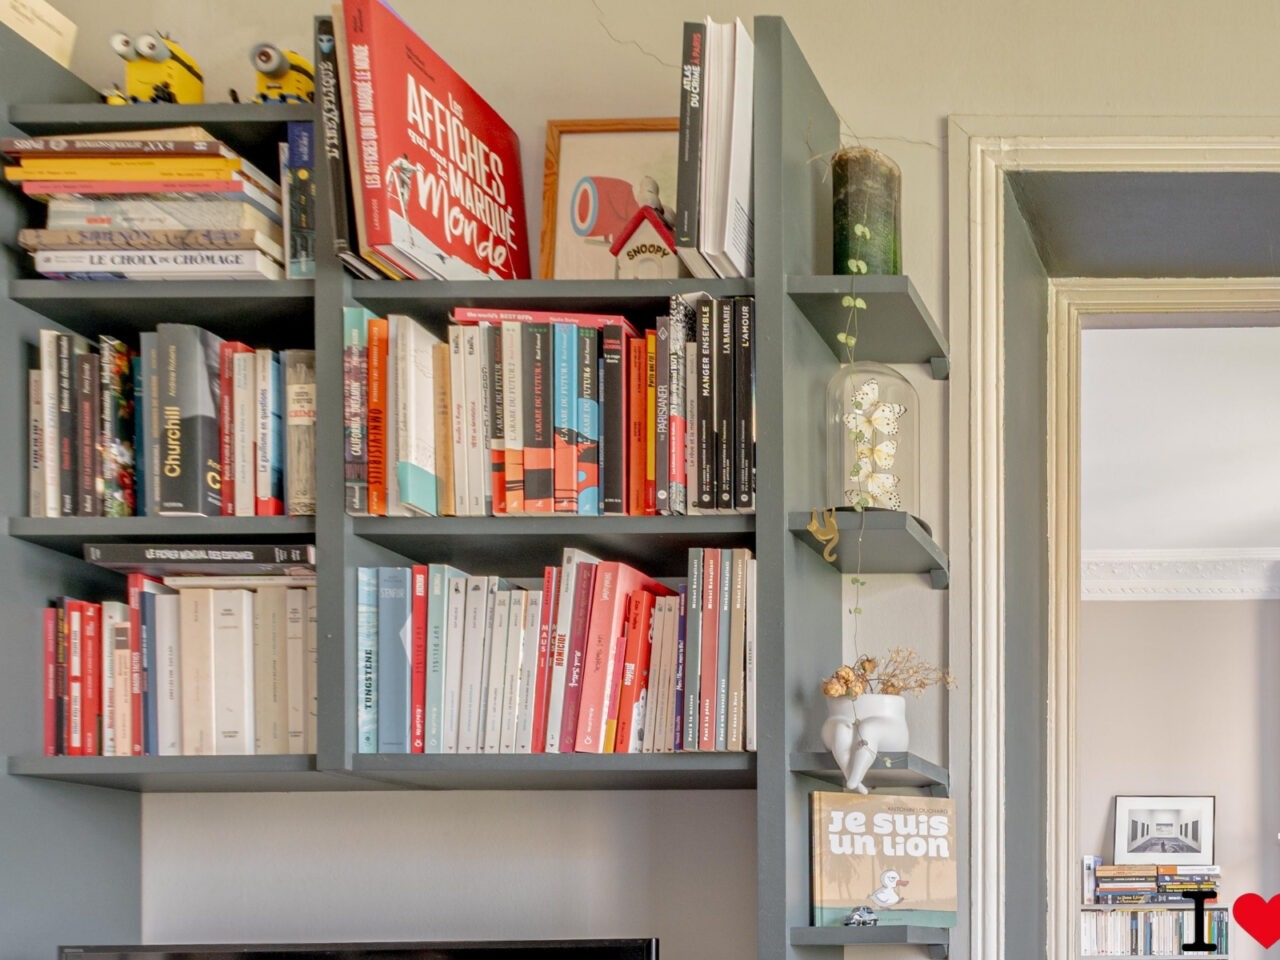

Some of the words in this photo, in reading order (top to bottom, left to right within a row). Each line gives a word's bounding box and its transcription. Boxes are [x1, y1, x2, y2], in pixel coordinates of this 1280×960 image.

[352, 43, 370, 70] MONDE
[692, 33, 701, 57] PARIS
[355, 71, 371, 80] LE
[683, 63, 692, 91] ATLAS
[691, 65, 700, 92] CRIME
[354, 80, 374, 110] MARQUÉ
[448, 92, 463, 121] Les
[691, 92, 700, 108] DU
[360, 127, 377, 140] QUI
[406, 73, 506, 206] AFFICHES
[361, 140, 380, 173] AFFICHES
[364, 174, 381, 189] LES
[450, 169, 518, 251] MARQUÉ
[89, 254, 108, 265] LE
[111, 254, 158, 266] CHOIX
[173, 251, 245, 266] CHÔMAGE
[626, 244, 670, 260] SNOOPY
[701, 306, 710, 354] ENSEMBLE
[741, 306, 749, 348] L'AMOUR
[723, 344, 730, 353] LA
[495, 363, 503, 392] FUTUR
[534, 366, 542, 394] FUTUR
[560, 368, 568, 395] FUTUR
[583, 372, 591, 398] FUTUR
[702, 357, 710, 396] MANGER
[258, 388, 269, 420] questions
[495, 392, 503, 404] DU
[534, 395, 542, 407] DU
[657, 384, 667, 432] PARISIANER
[163, 406, 181, 477] Churchill
[350, 416, 362, 456] CALIFORNIA
[555, 633, 567, 667] HOMICIDE
[362, 648, 373, 710] TUNGSTÈNE
[873, 812, 949, 836] suis
[828, 834, 877, 856] un
[882, 836, 950, 858] lion
